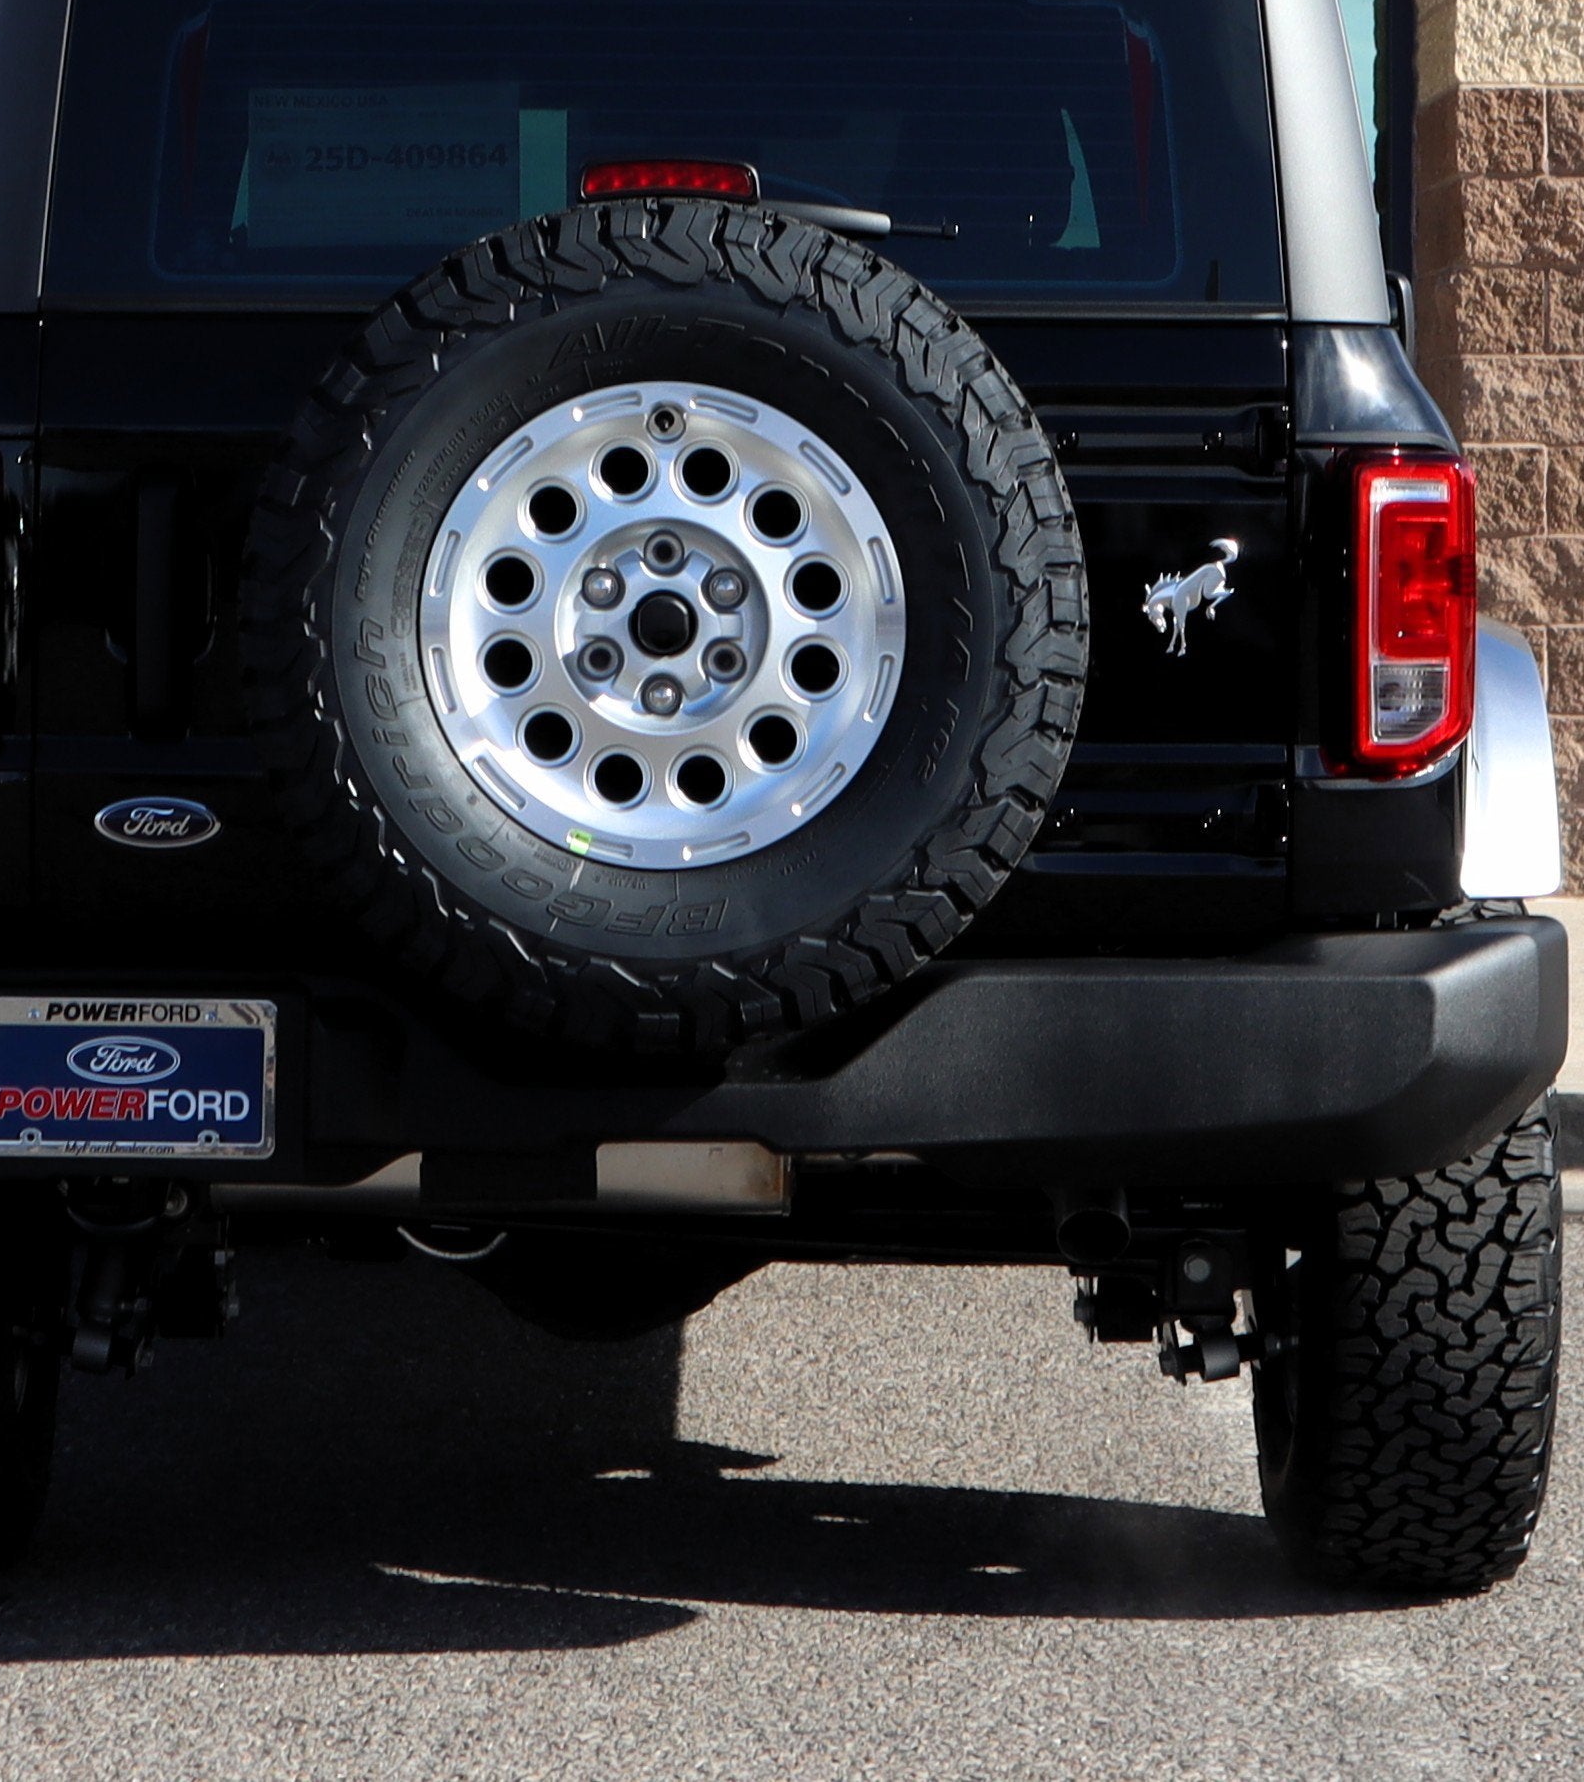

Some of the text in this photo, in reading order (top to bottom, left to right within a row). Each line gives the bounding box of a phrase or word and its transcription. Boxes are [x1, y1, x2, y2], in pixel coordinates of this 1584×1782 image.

[353, 618, 729, 937] BFGoodrich
[123, 806, 191, 836] Ford
[46, 1002, 201, 1023] POWERFORD
[90, 1042, 158, 1074] Ford
